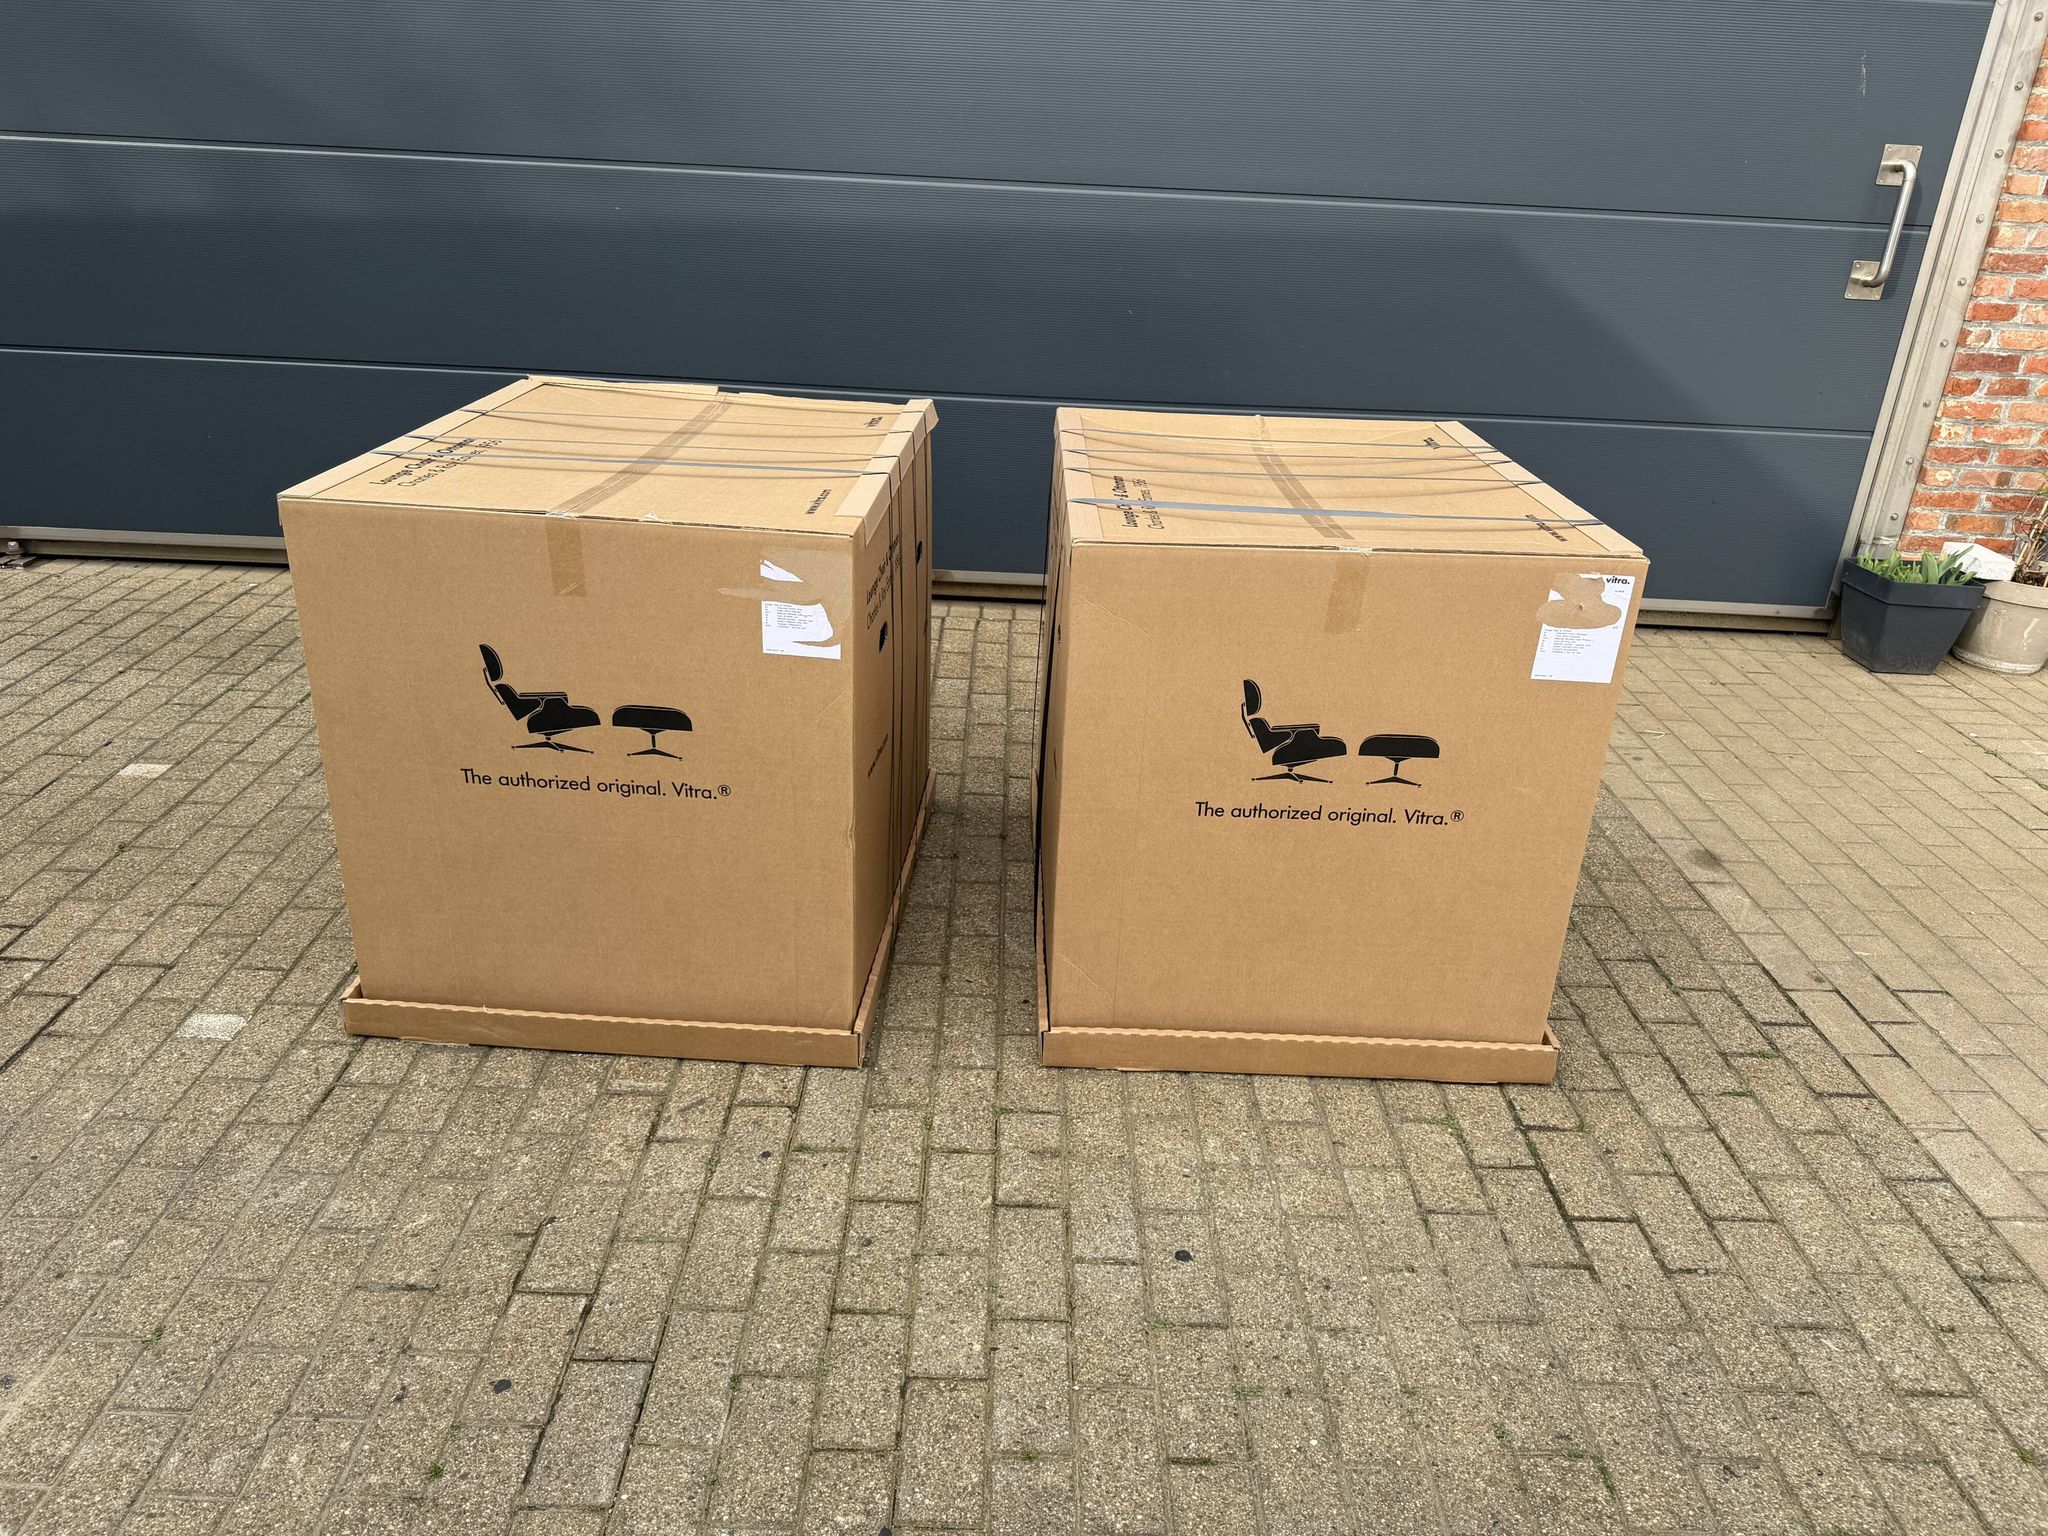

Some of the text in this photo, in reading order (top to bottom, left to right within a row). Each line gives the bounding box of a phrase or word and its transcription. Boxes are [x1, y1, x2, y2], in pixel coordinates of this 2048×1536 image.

[369, 470, 413, 484] Lounge
[1606, 576, 1630, 584] vitra.
[460, 768, 492, 785] The
[498, 772, 590, 791] authorized
[597, 778, 666, 798] original.
[1195, 801, 1225, 817] The
[1231, 803, 1322, 821] authorized
[1328, 807, 1397, 826] original.
